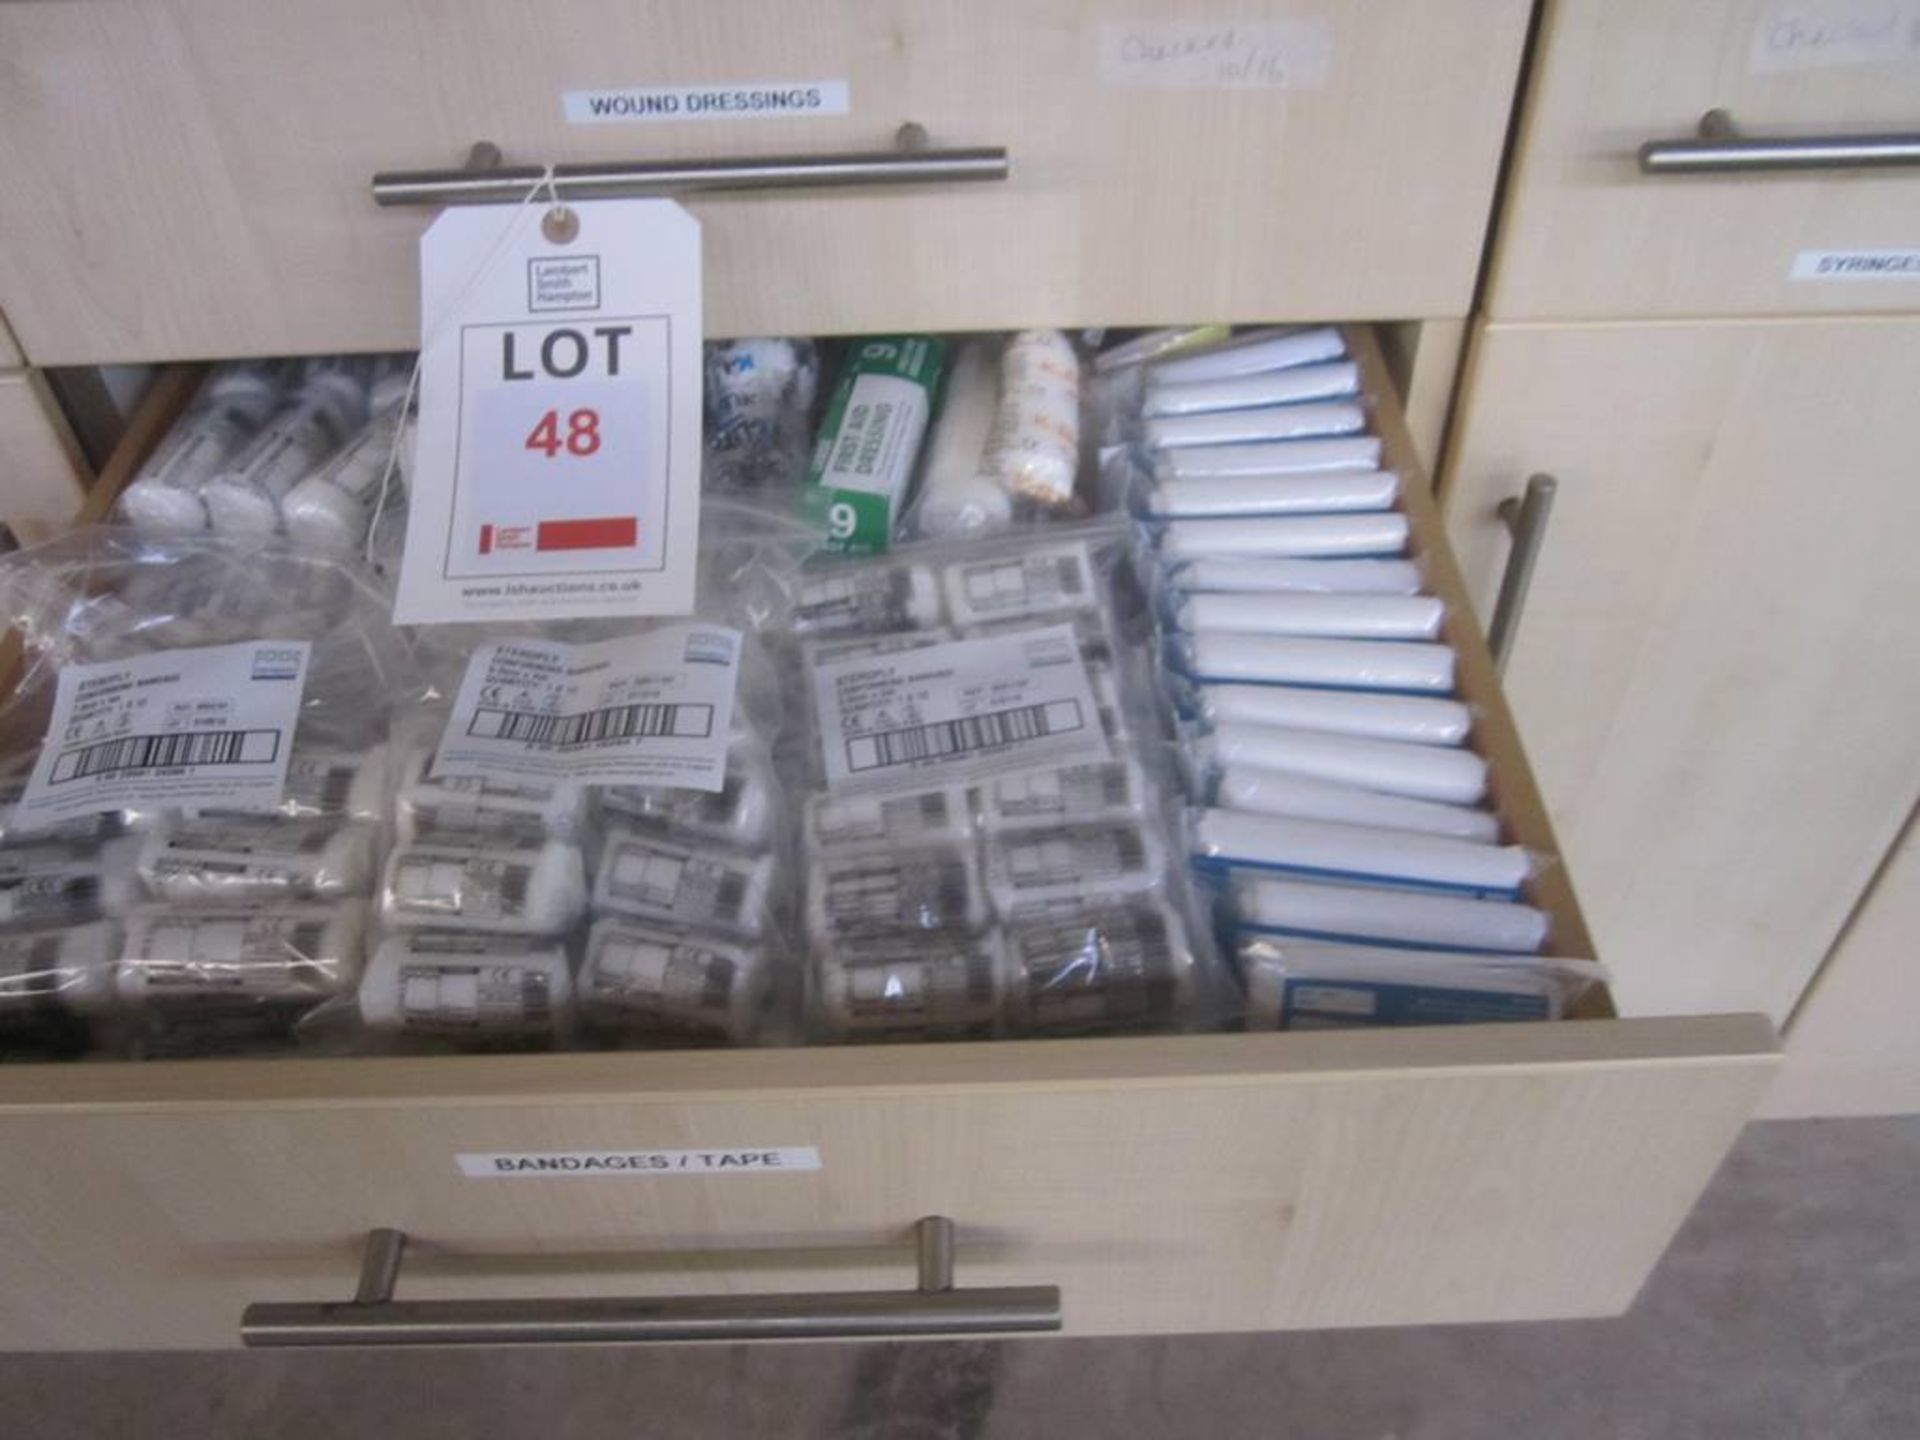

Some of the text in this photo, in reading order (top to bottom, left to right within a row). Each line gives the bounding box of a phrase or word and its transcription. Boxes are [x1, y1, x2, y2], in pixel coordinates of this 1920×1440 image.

[589, 88, 821, 116] WOUND DRESSINGS
[502, 326, 632, 381] LOT
[525, 408, 601, 458] 48
[832, 403, 870, 473] FIRST AID
[854, 401, 893, 476] DRESSING
[830, 502, 857, 539] 9
[495, 1152, 781, 1172] BANDAGES / TAPE
